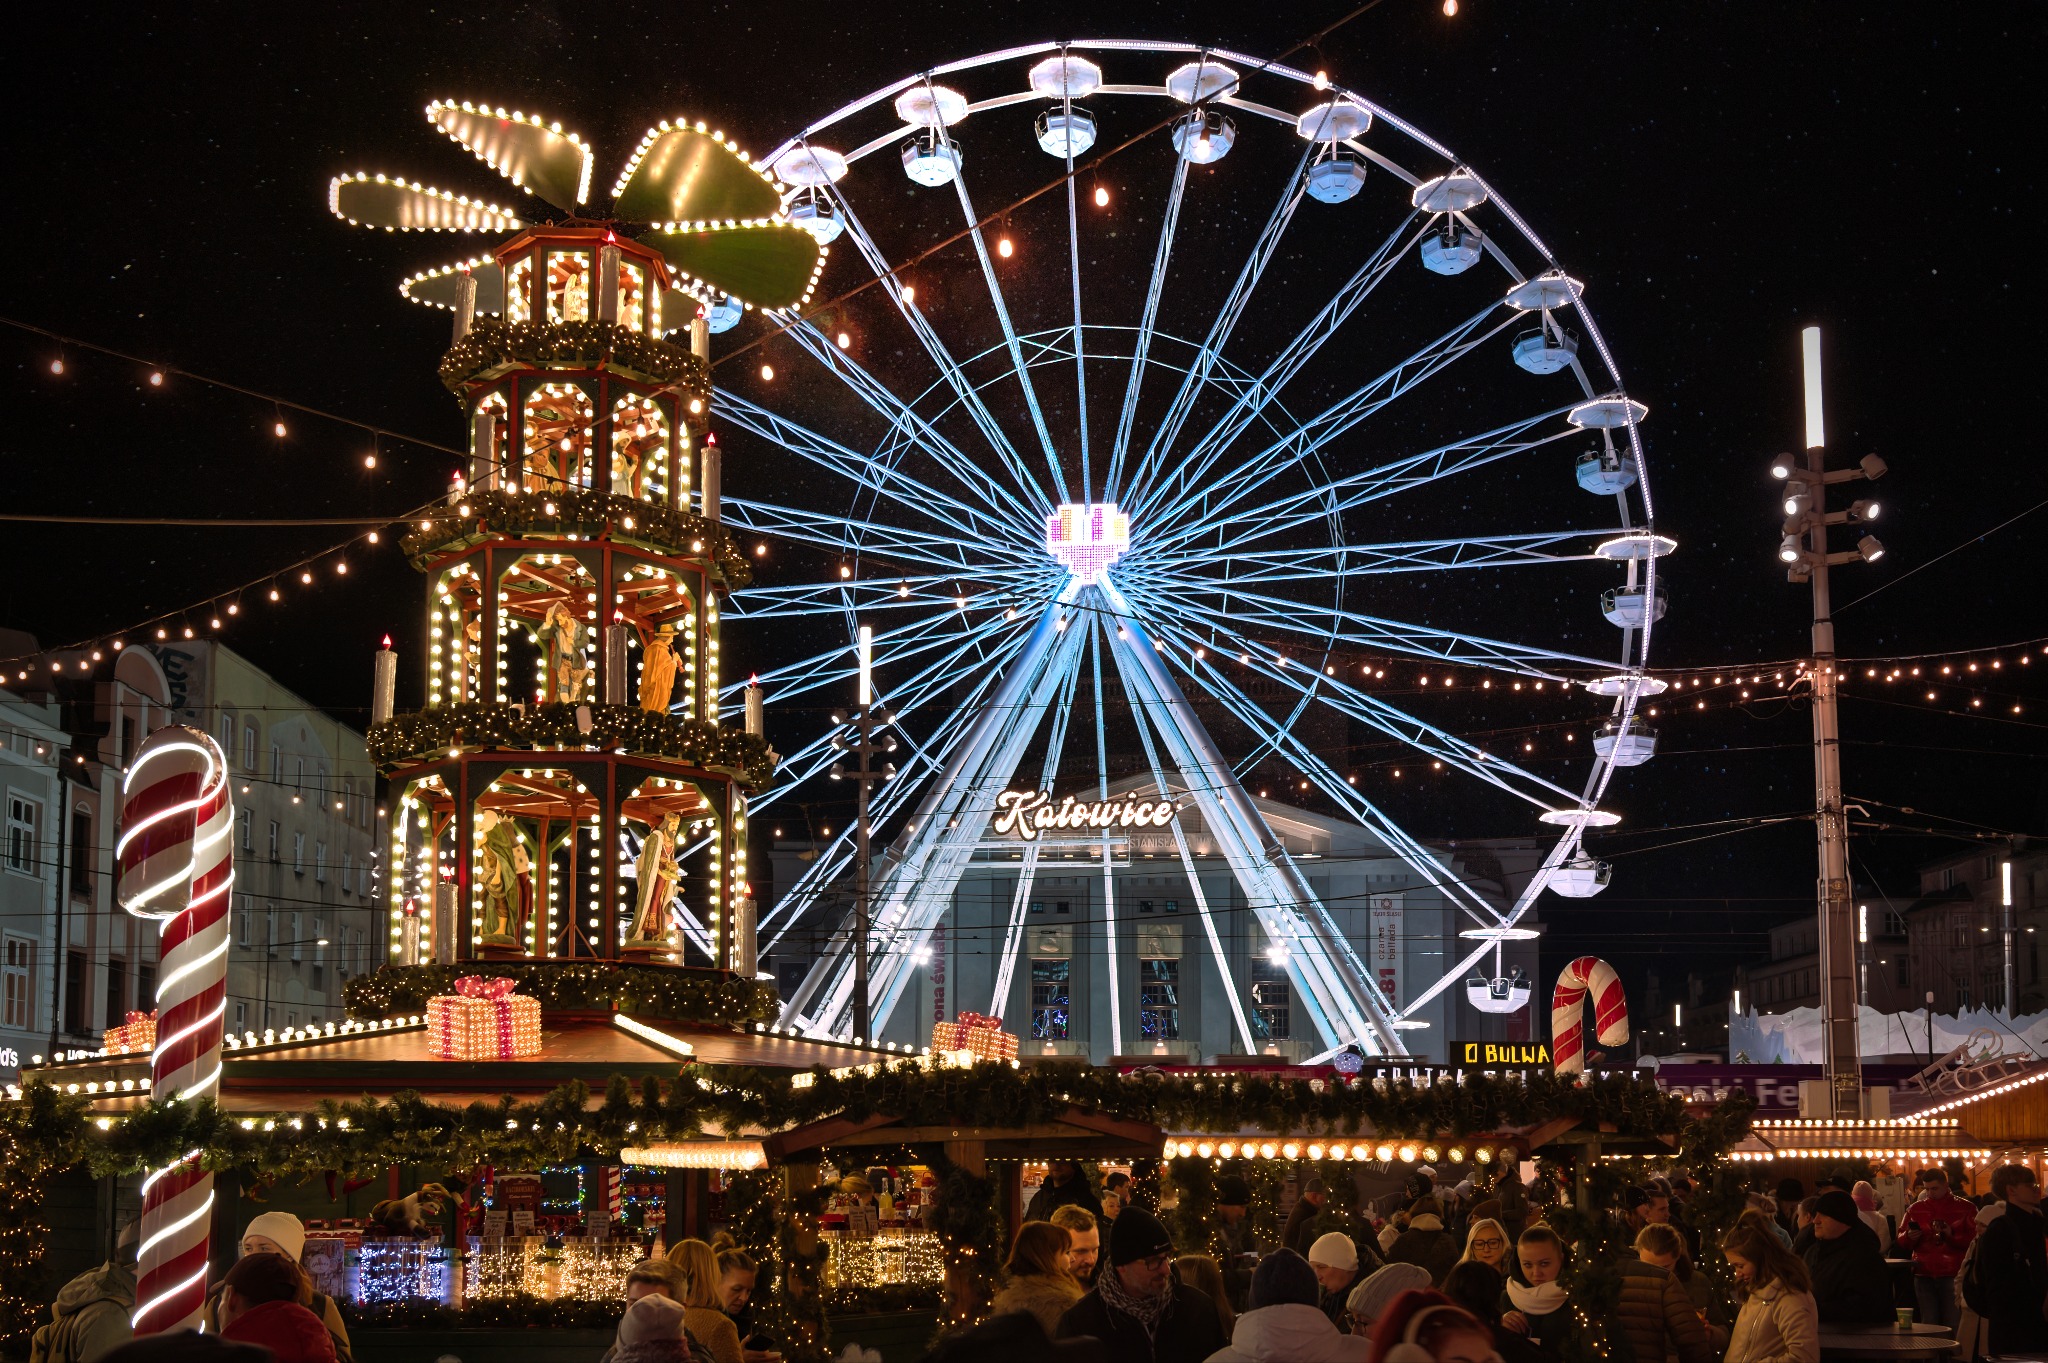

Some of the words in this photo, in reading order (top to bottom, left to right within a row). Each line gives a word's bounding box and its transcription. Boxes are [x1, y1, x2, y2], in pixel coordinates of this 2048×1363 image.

[994, 790, 1175, 840] Katowice
[1388, 923, 1396, 960] ballada
[1485, 1044, 1550, 1063] BULWA
